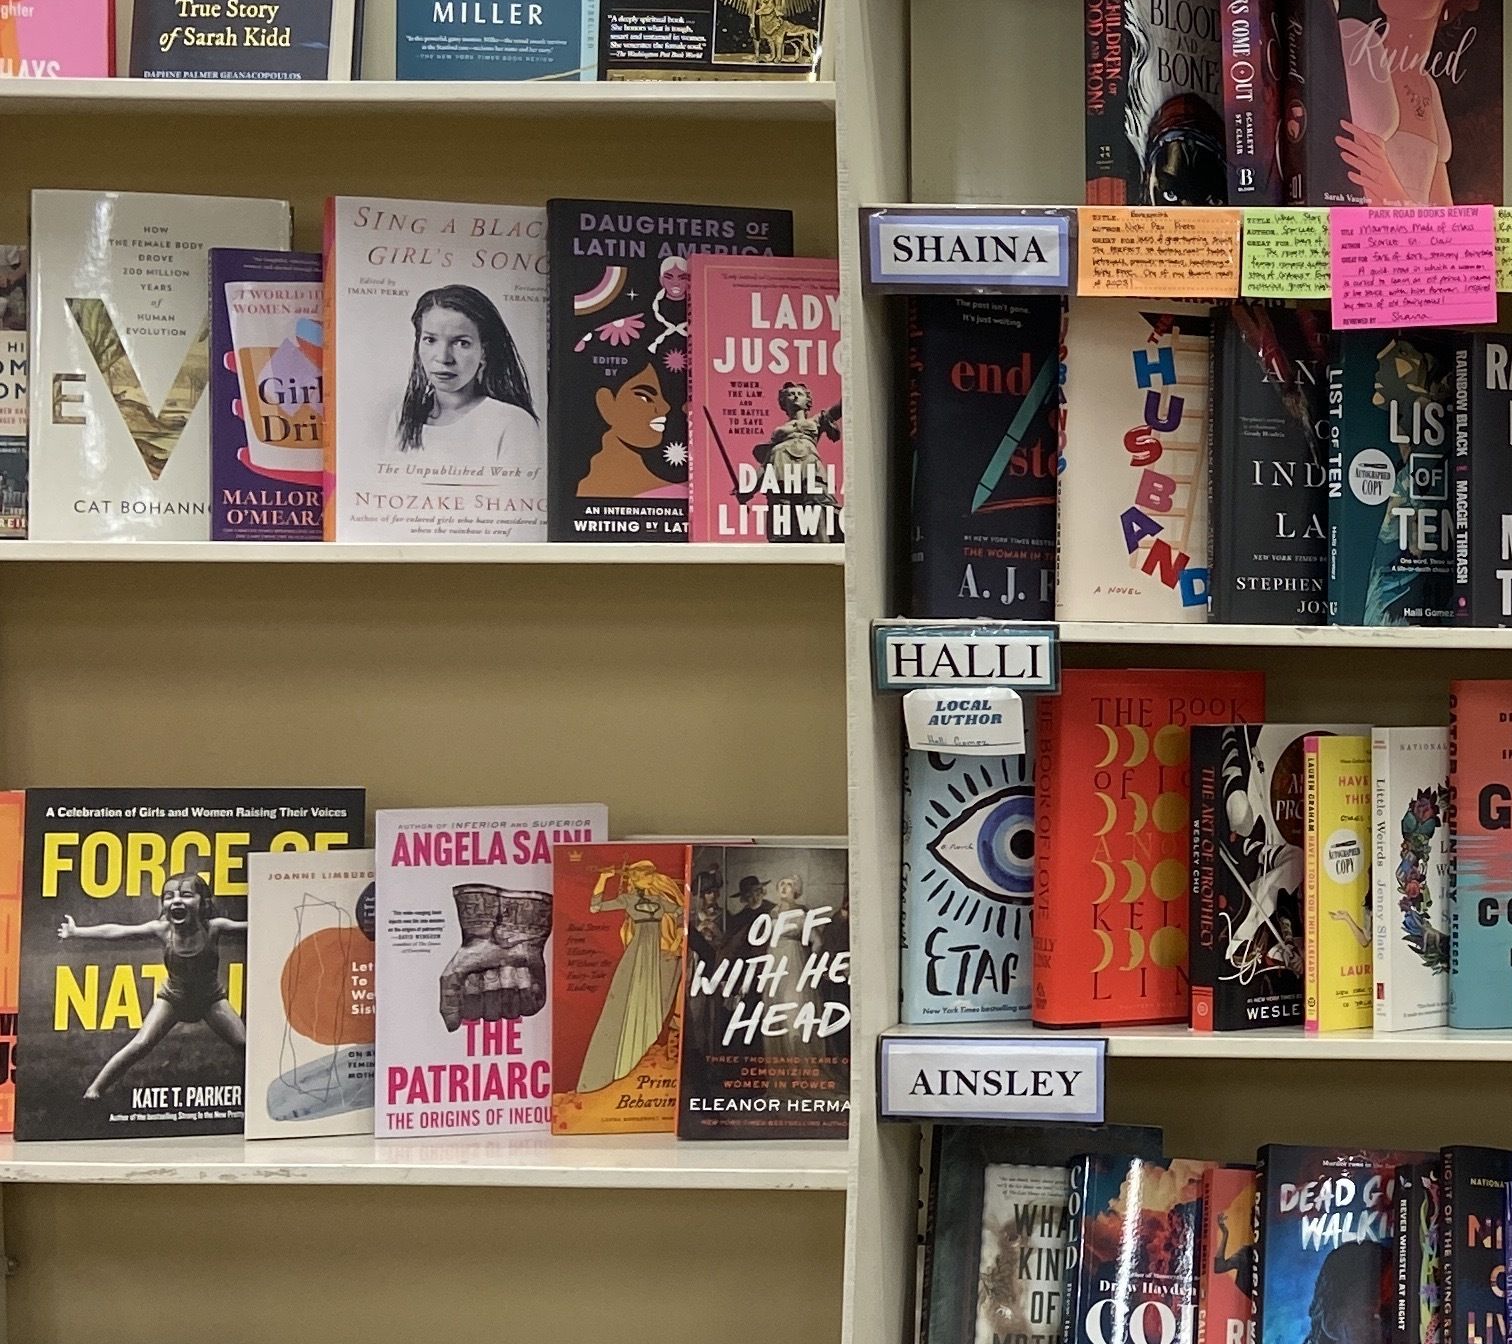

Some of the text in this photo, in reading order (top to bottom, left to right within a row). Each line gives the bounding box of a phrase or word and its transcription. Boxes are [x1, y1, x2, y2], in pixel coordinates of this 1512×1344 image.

[433, 3, 543, 25] MILLER
[579, 212, 769, 238] DAUGHTERS OF
[893, 235, 1047, 264] SHAINA
[891, 643, 1043, 678] HALLI
[747, 907, 833, 946] OFF
[909, 1069, 1082, 1096] AINSLEY
[132, 1086, 241, 1108] KATE T. PARKER
